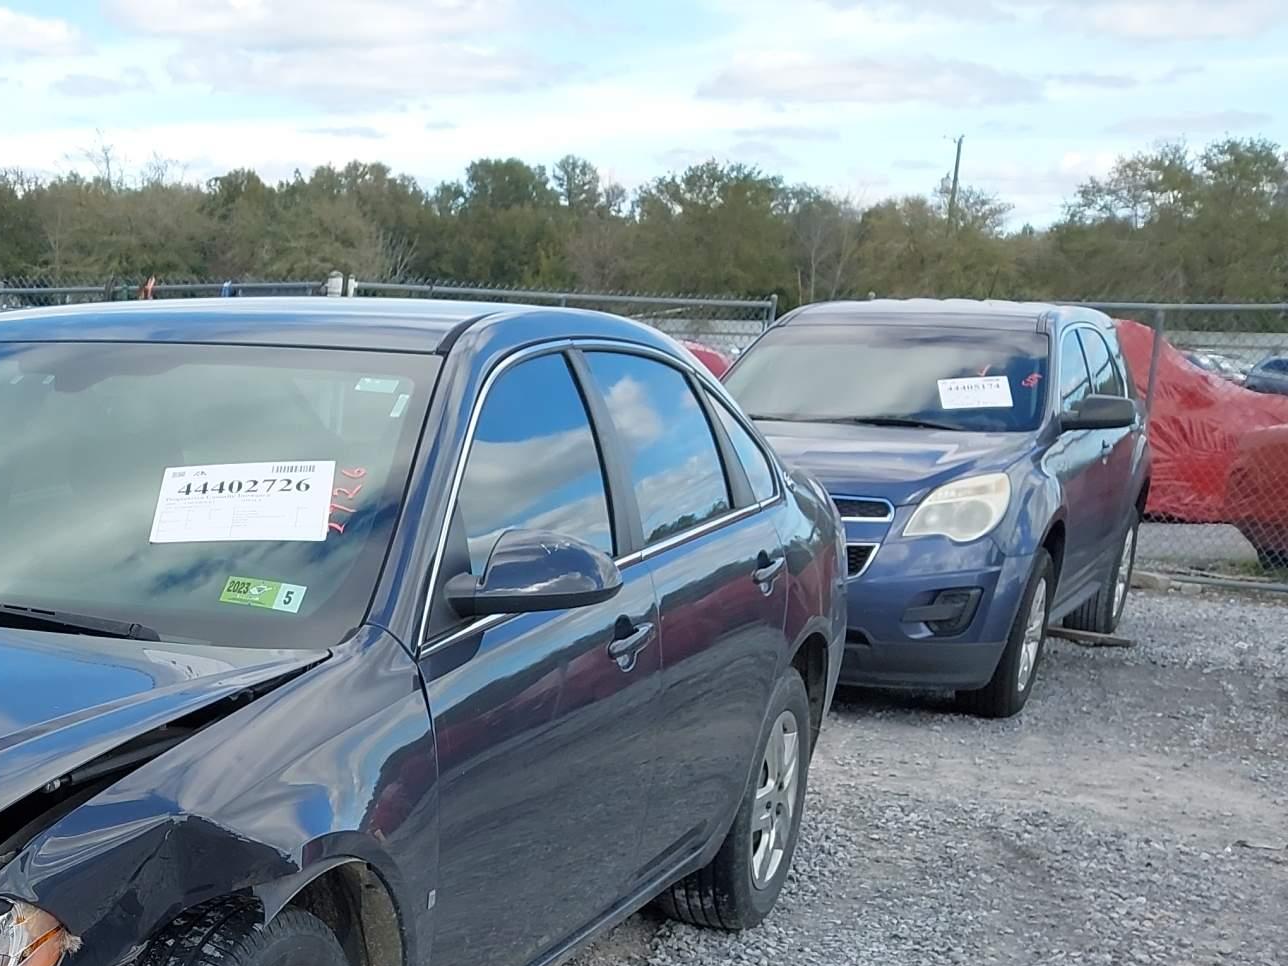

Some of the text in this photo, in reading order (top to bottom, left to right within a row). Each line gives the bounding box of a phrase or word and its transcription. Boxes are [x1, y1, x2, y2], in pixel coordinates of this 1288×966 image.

[177, 478, 312, 496] 44402726
[226, 580, 295, 605] 2023 5
